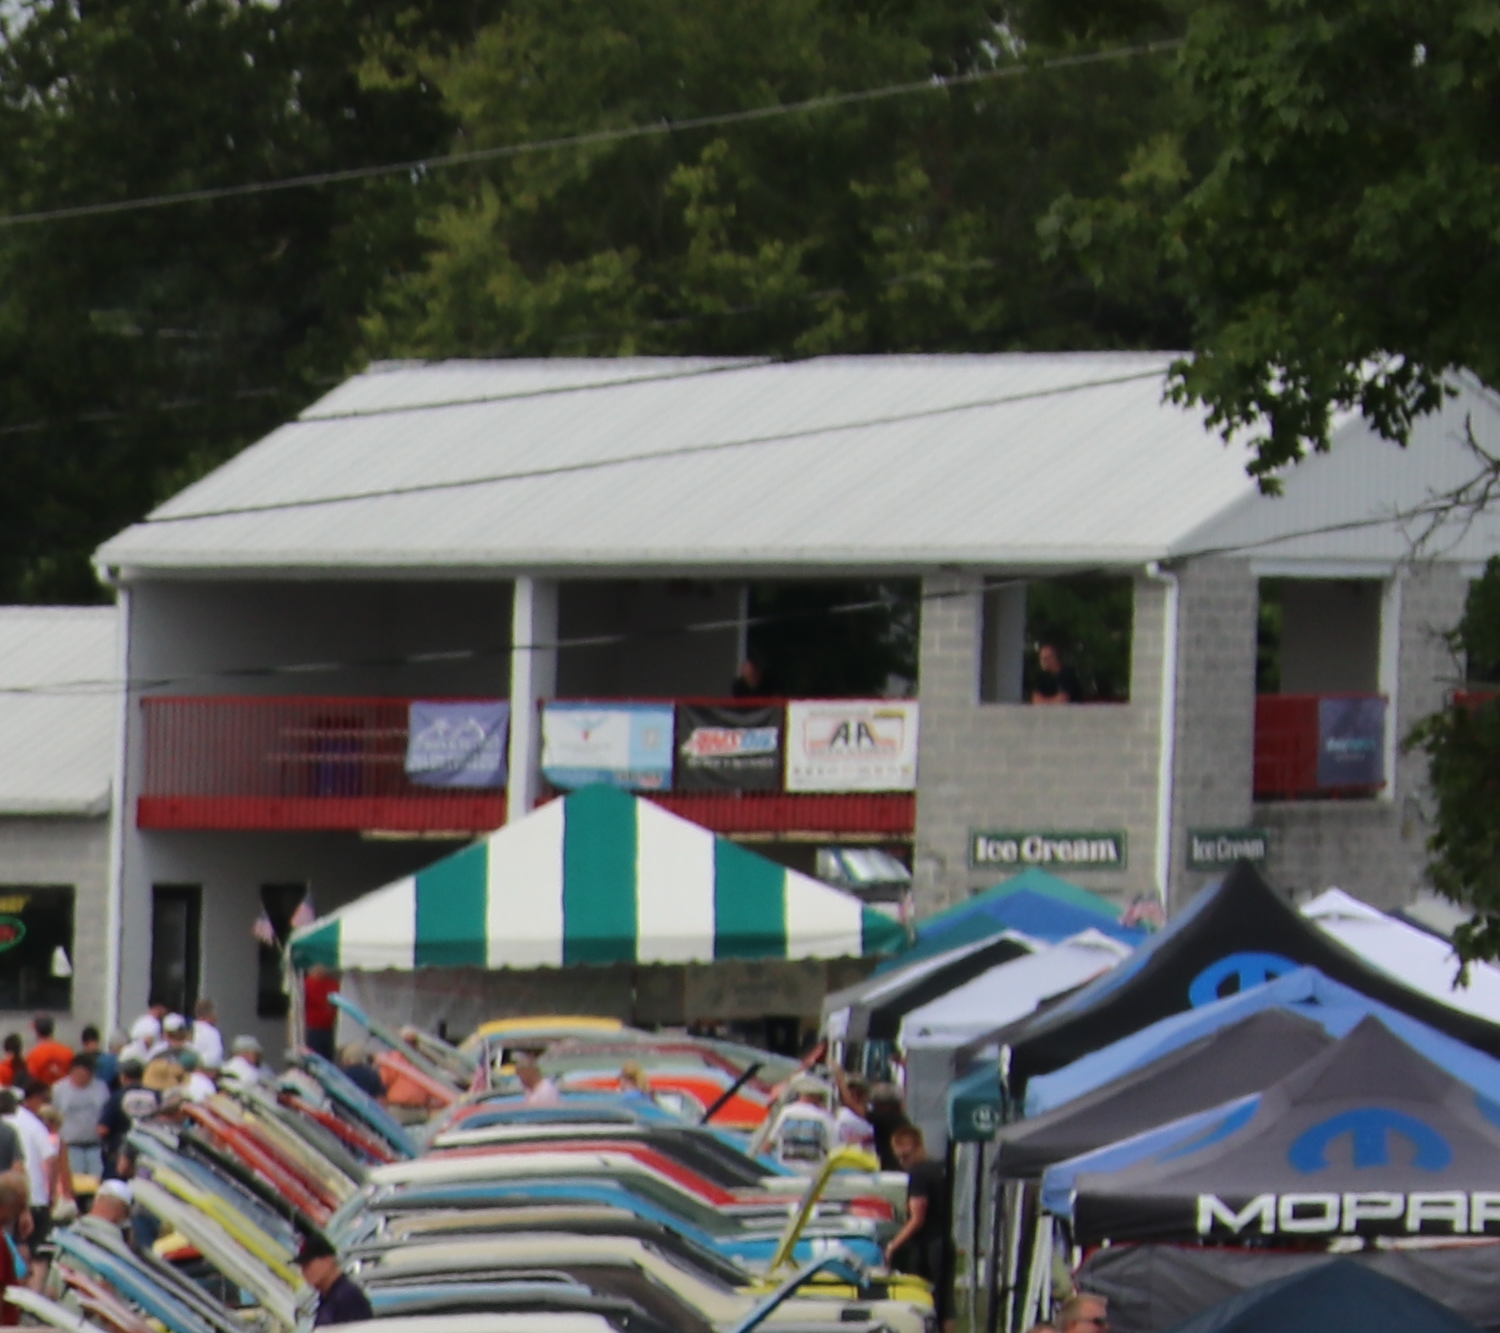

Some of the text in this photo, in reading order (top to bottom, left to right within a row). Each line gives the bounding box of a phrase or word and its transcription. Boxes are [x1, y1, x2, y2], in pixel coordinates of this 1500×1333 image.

[975, 835, 1117, 863] Ice Cream
[1192, 836, 1265, 862] Ice Cream
